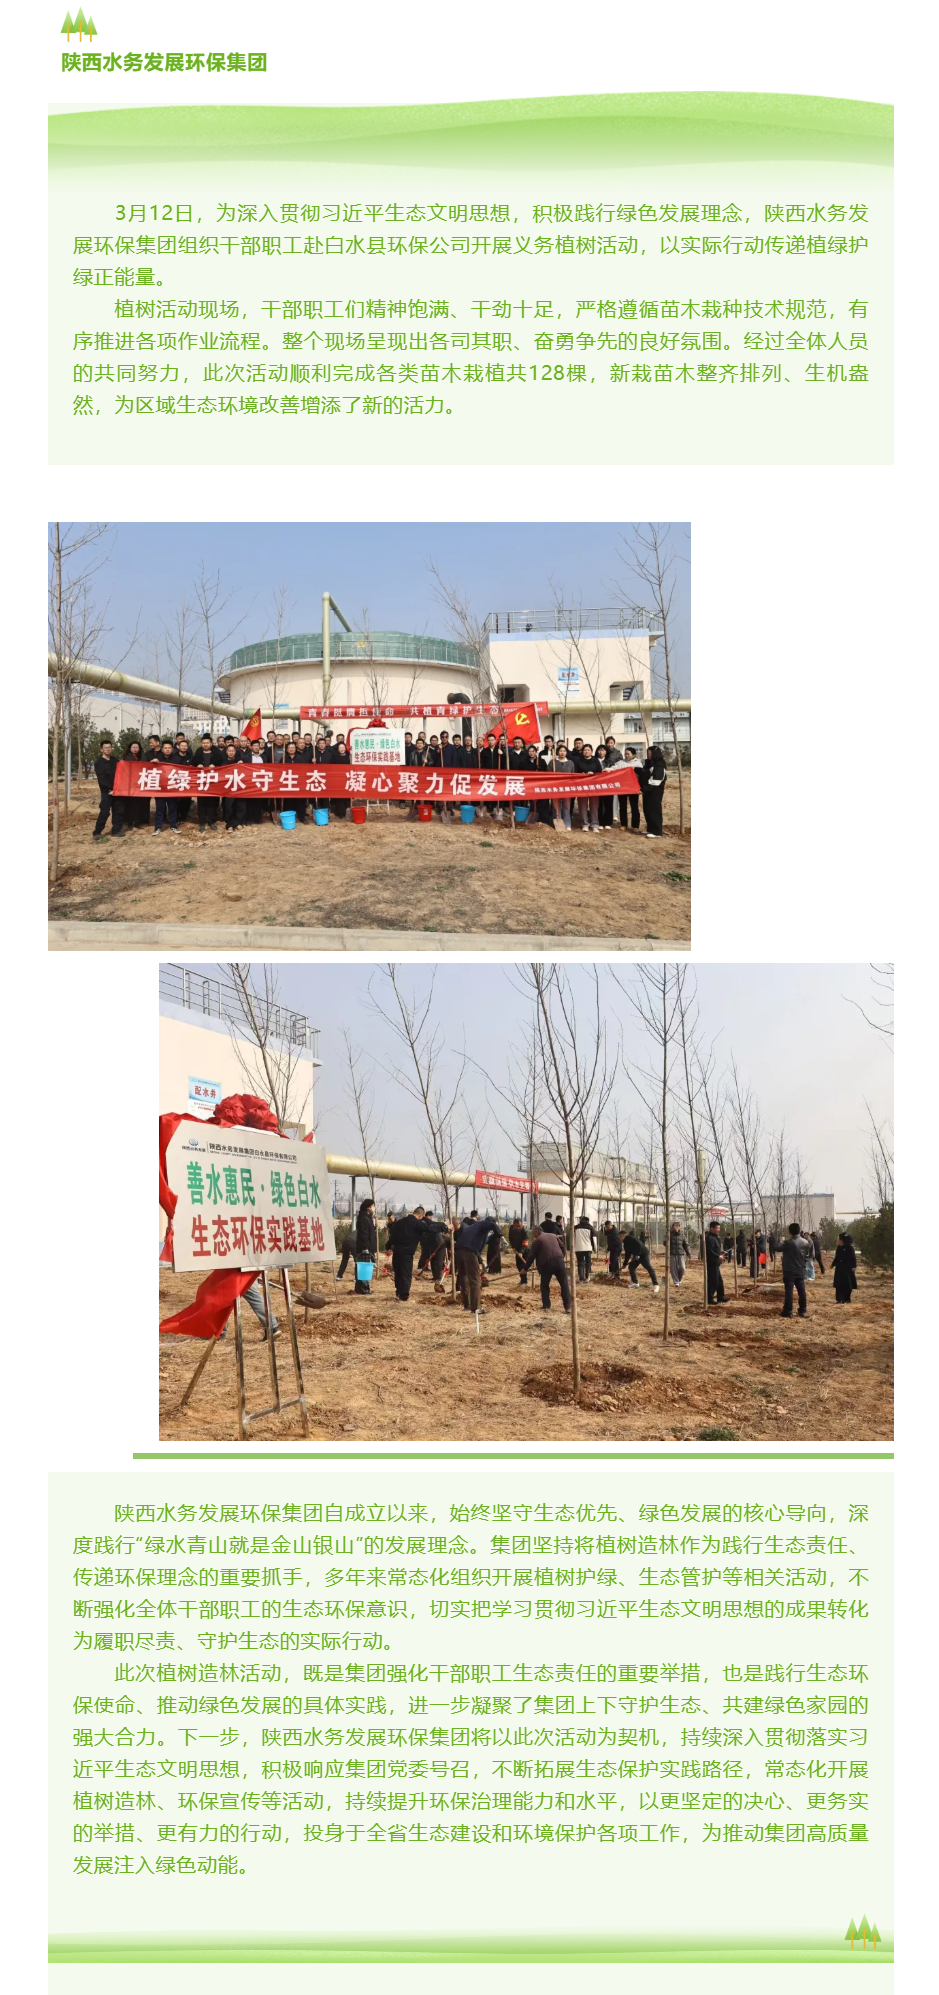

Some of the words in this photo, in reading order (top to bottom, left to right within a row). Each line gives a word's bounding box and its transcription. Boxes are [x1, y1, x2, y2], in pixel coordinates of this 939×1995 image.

[61, 52, 267, 72] 陕西水务发展环保集团
[116, 203, 869, 223] 3月12日，为深入贯彻习近平生态文明思想，积极践行绿色发展理念，陕西水务发
[73, 235, 868, 255] 展环保集团组织干部职工赴白水县环保公司开展义务植树活动，以实际行动传递植绿护
[73, 267, 163, 287] 绿正能量。
[114, 299, 869, 320] 植树活动现场，干部职工们精神饱满、干劲十足，严格遵循苗木栽种技术规范，有
[73, 331, 869, 351] 序推进各项作业流程。整个现场呈现出各司其职、奋勇争先的良好氛围。经过全体人员
[73, 363, 869, 383] 的共同努力，此次活动顺利完成各类苗木栽植共128棵，新栽苗木整齐排列、生机盎
[73, 395, 452, 415] 然，为区域生态环境改善增添了新的活力。
[410, 705, 499, 716] 共植青绿护生态
[137, 767, 327, 792] 植绿护水守生态
[344, 770, 526, 796] 凝心聚力促发展
[194, 1085, 217, 1099] 配水井
[191, 1214, 325, 1257] 生态环保实践基地
[114, 1503, 869, 1523] 陕西水务发展环保集团自成立以来，始终坚守生态优先、绿色发展的核心导向，深
[73, 1567, 869, 1587] 传递环保理念的重要抓手，多年来常态化组织开展植树护绿、生态管护等相关活动，不
[73, 1599, 869, 1619] 断强化全体干部职工的生态环保意识，切实把学习贯彻习近平生态文明思想的成果转化
[73, 1631, 391, 1651] 为履职尽责、守护生态的实际行动。
[114, 1663, 869, 1683] 此次植树造林活动，既是集团强化干部职工生态责任的重要举措，也是践行生态环
[73, 1695, 869, 1715] 保使命、推动绿色发展的具体实践，进一步凝聚了集团上下守护生态、共建绿色家园的
[73, 1727, 868, 1747] 强大合力。下一步，陕西水务发展环保集团将以此次活动为契机，持续深入贯彻落实习
[73, 1759, 869, 1779] 近平生态文明思想，积极响应集团党委号召，不断拓展生态保护实践路径，常态化开展
[73, 1791, 869, 1811] 植树造林、环保宣传等活动，持续提升环保治理能力和水平，以更坚定的决心、更务实
[73, 1823, 869, 1843] 的举措、更有力的行动，投身于全省生态建设和环境保护各项工作，为推动集团高质量
[73, 1855, 246, 1875] 发展注入绿色动能。
